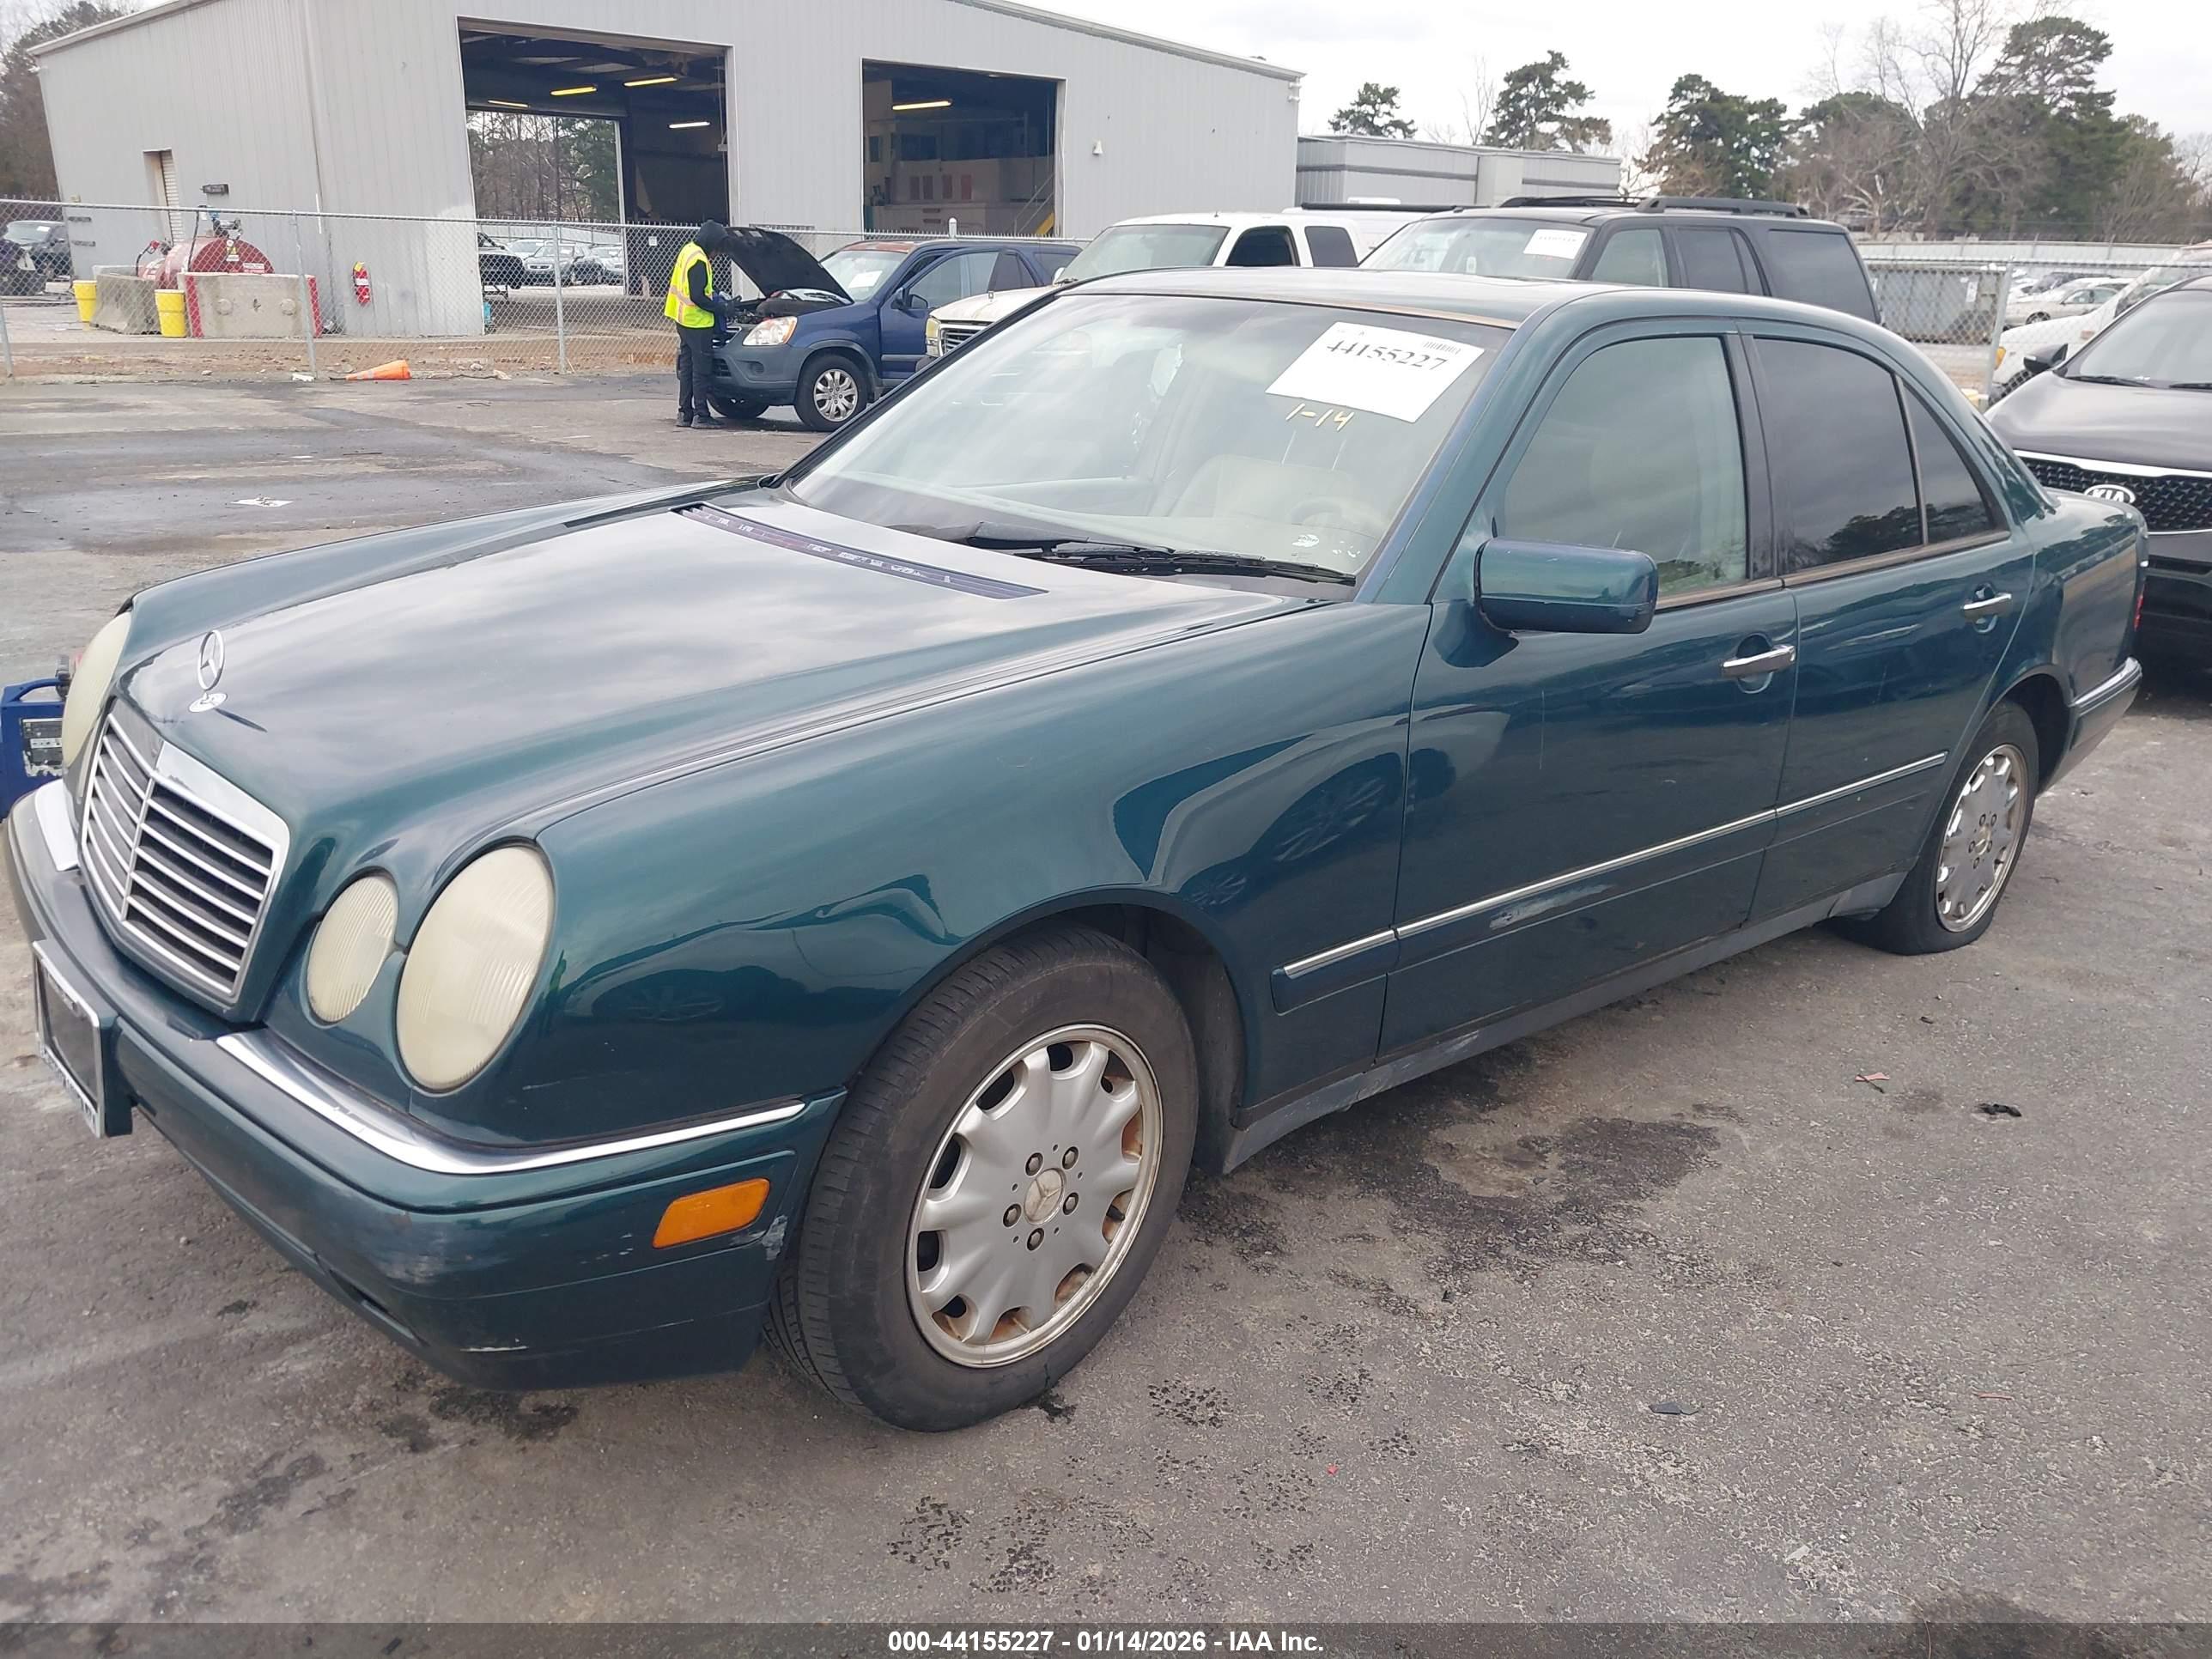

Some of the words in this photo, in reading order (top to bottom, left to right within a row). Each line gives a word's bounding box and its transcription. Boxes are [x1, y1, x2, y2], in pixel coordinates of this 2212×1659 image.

[1327, 340, 1448, 370] 44155227
[1285, 403, 1355, 431] 1-14
[2091, 489, 2124, 502] KIA
